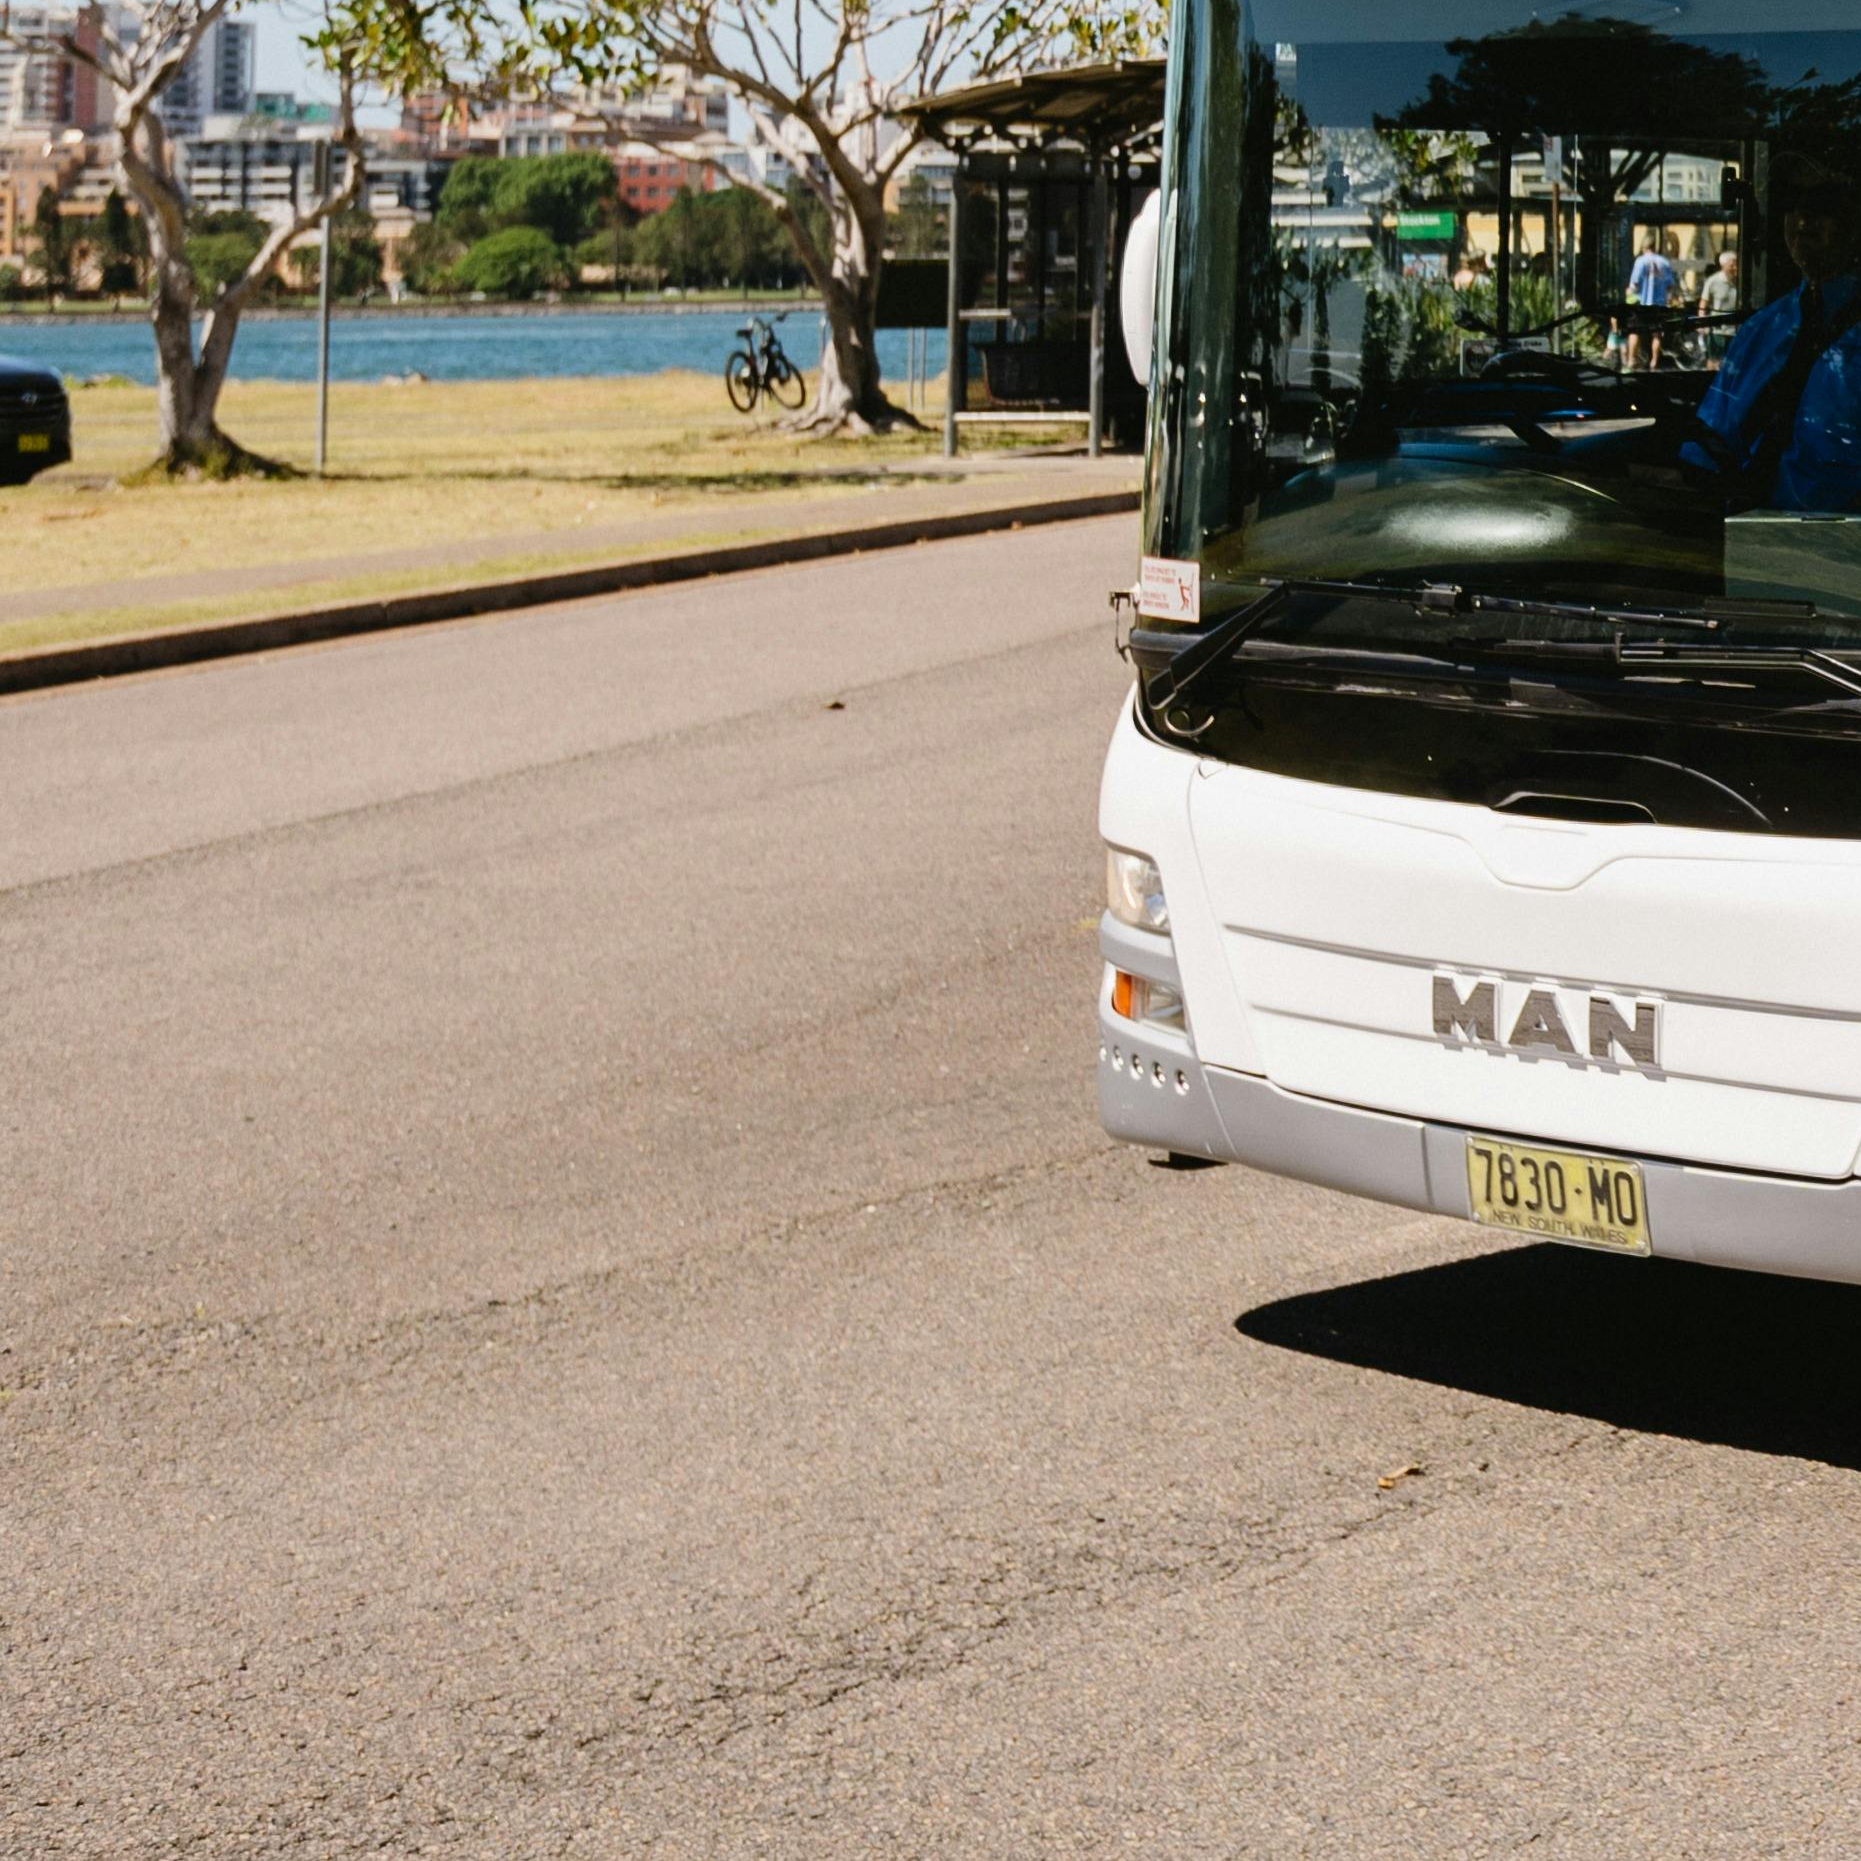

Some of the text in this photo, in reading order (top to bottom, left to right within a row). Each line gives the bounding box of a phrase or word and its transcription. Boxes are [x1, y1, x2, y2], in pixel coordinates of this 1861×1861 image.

[1432, 973, 1658, 1065] MAN
[1491, 1209, 1629, 1245] NEW SOUTH WALES
